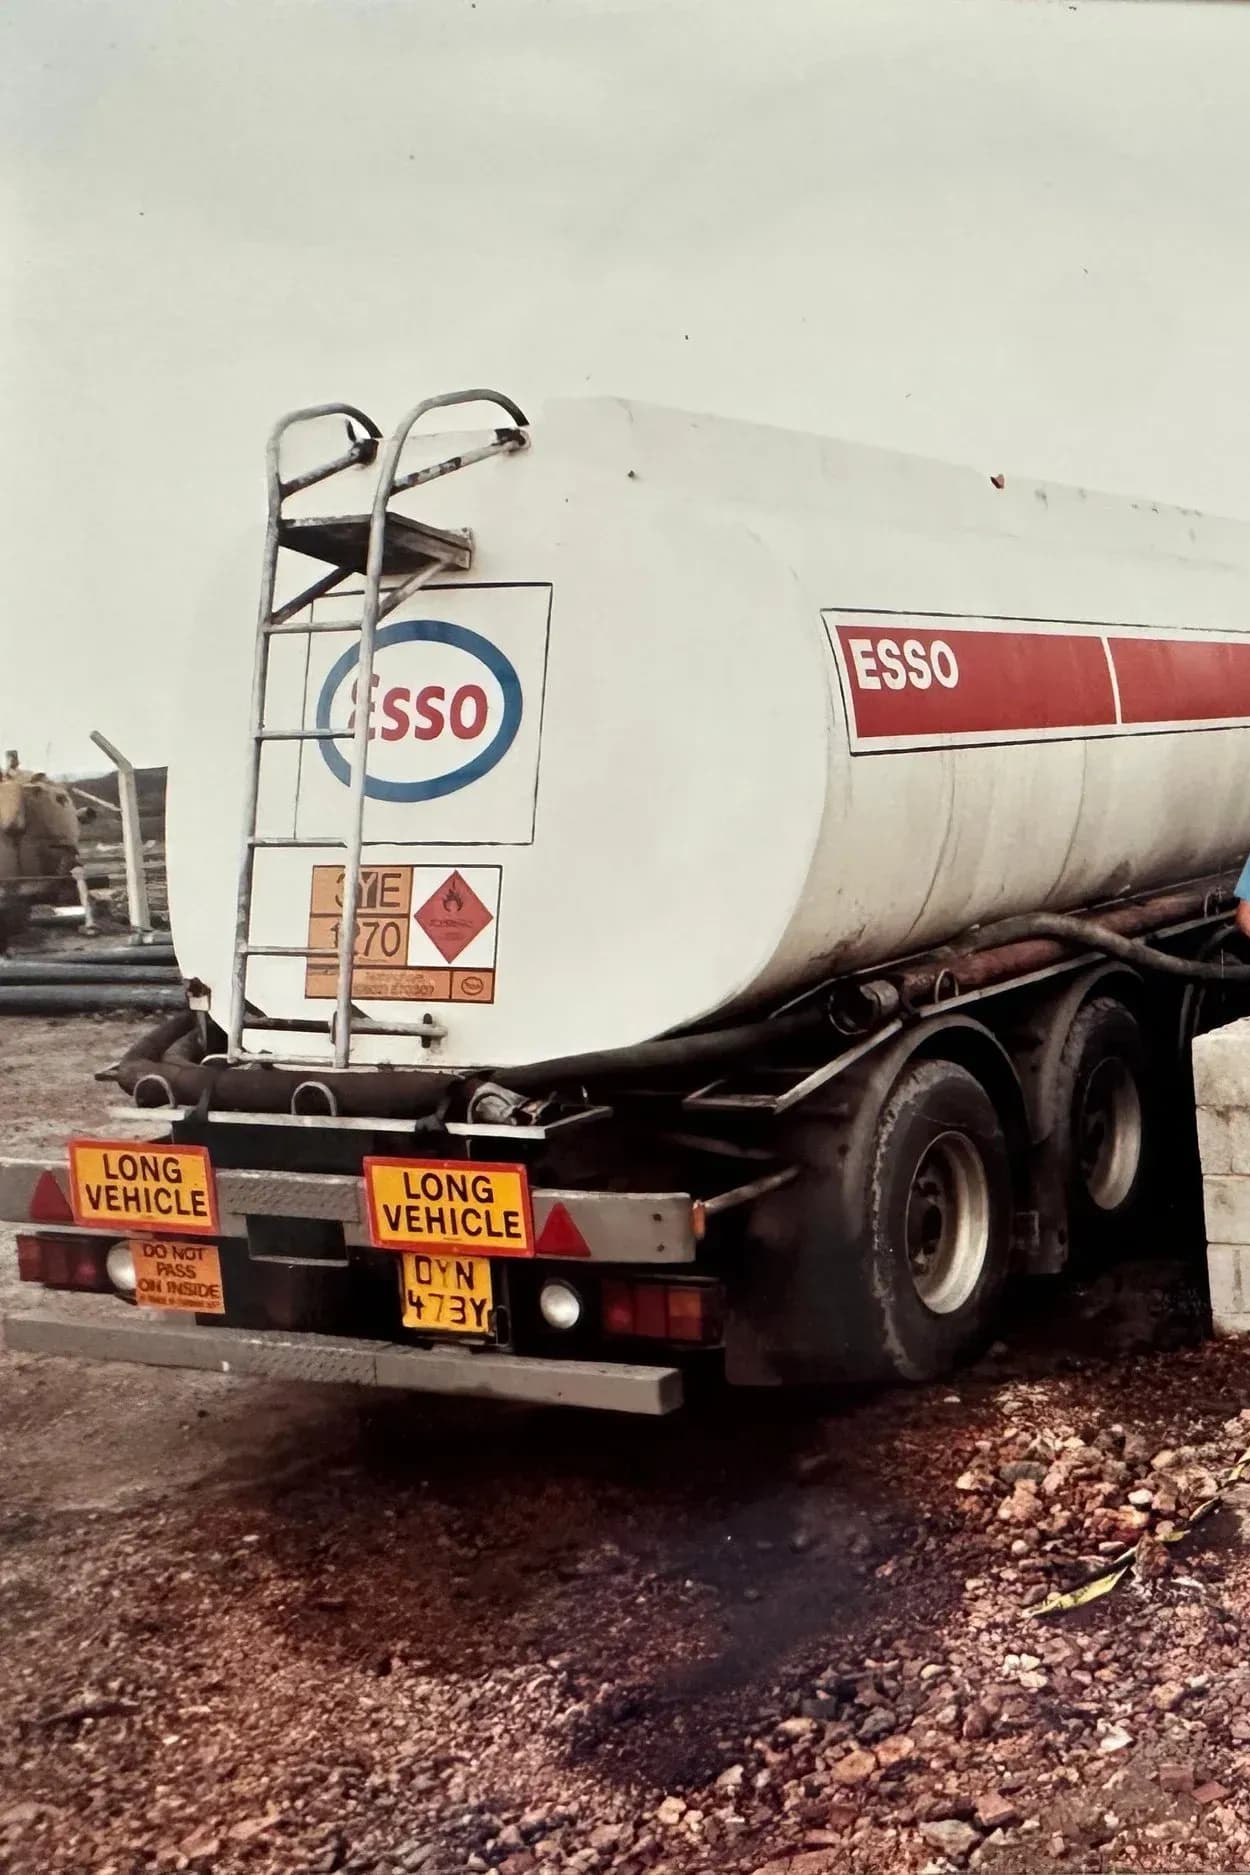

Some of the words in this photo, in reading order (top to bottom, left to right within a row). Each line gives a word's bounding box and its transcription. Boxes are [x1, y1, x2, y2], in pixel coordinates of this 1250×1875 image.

[848, 638, 959, 690] ESSO
[330, 921, 401, 957] 170
[103, 1153, 183, 1184] LONG
[85, 1183, 208, 1217] VEHICLE
[403, 1171, 494, 1204] LONG
[382, 1204, 522, 1239] VEHICLE
[143, 1243, 168, 1259] DO
[172, 1245, 206, 1261] NOT
[156, 1261, 197, 1279] PASS
[138, 1278, 162, 1293] ON
[166, 1281, 220, 1299] INSIDE
[408, 1290, 487, 1328] 473Y
